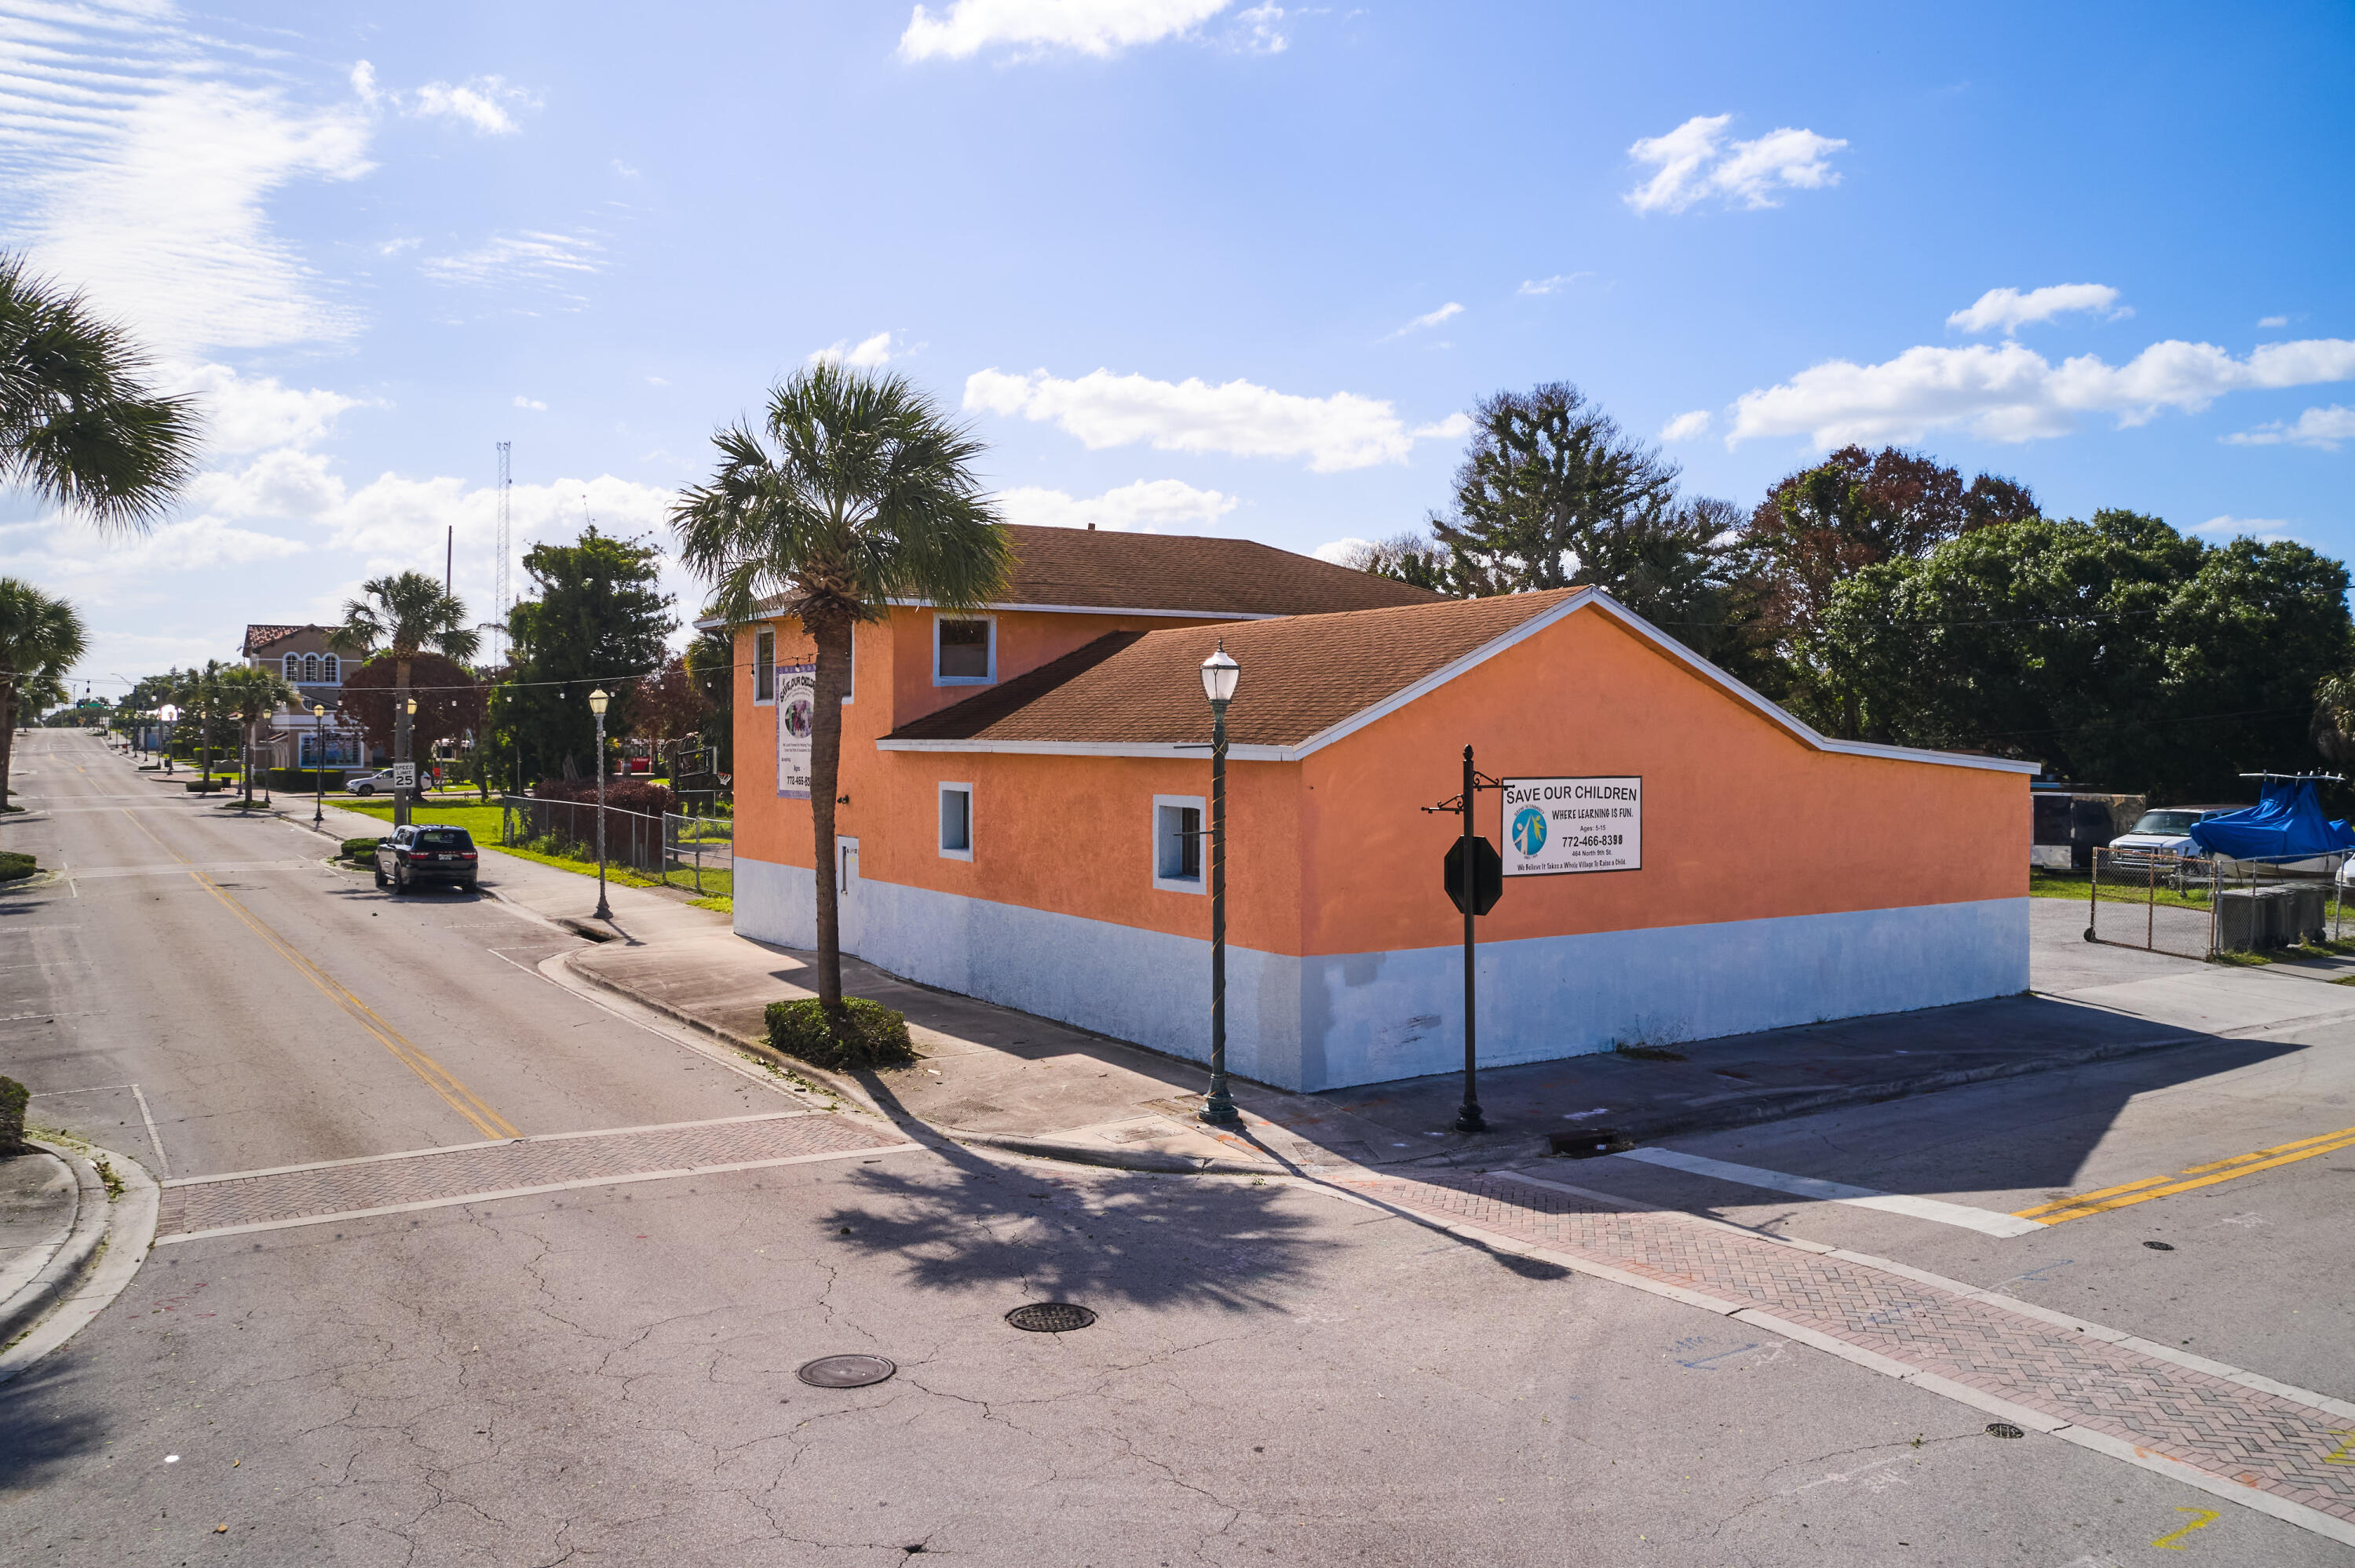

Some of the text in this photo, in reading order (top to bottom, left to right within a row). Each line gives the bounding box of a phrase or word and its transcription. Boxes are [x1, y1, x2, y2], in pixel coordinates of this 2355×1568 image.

[791, 676, 801, 687] OUR
[396, 775, 413, 786] 25
[1506, 786, 1637, 804] SAVE OUR CHILDREN
[1552, 808, 1634, 820] WHERE LEARNING IS FUN.
